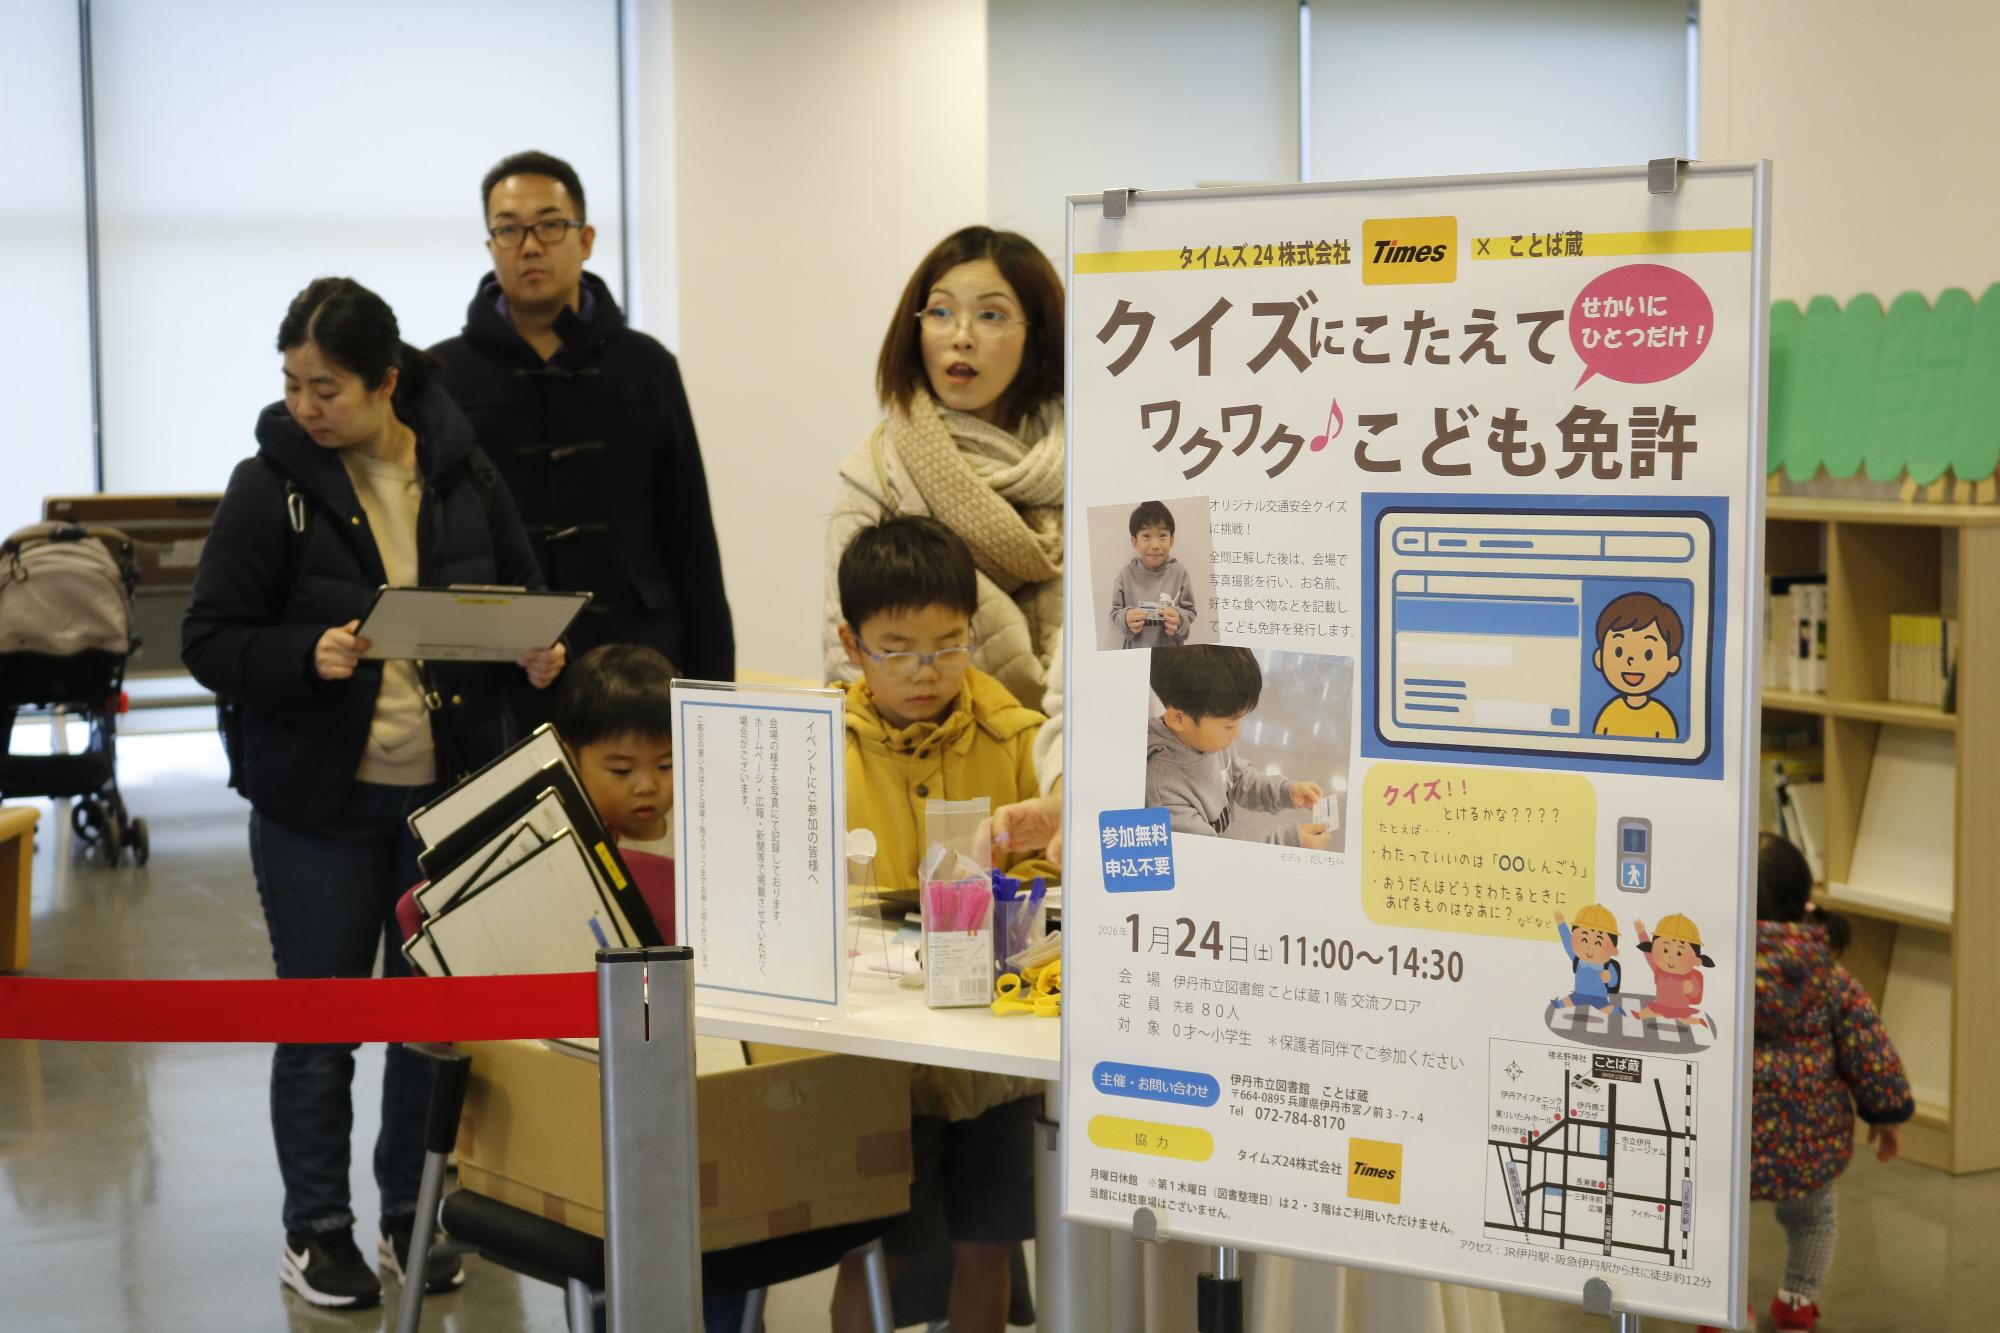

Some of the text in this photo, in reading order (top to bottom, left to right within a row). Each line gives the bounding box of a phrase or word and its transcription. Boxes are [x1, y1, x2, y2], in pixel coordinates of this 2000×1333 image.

[1180, 240, 1351, 270] タイムズ24株式会社
[1373, 238, 1447, 264] Times
[1509, 231, 1584, 258] ことば蔵
[1582, 295, 1668, 319] せかいに
[1097, 289, 1566, 377] クイズにこたえて
[1354, 405, 1698, 481] こども免許
[1209, 499, 1348, 513] オリジナル交通安全クイズ
[1209, 551, 1348, 567] 全問正解した後は、会場で
[1209, 598, 1348, 614] 好きな食べ物などを記載し
[806, 720, 820, 884] イベントにご参加の皆様へ
[1102, 823, 1169, 848] 参加無料
[1105, 856, 1171, 879] 申込不要
[1594, 1056, 1640, 1073] ことば蔵
[1100, 1072, 1209, 1099] 主催・お問い合わせ
[1230, 1073, 1369, 1103] 伊丹市立図書館 ことば蔵
[1230, 1105, 1345, 1131] Tel 072-784-8170
[1090, 1168, 1138, 1186] 月曜日休館
[1237, 1149, 1396, 1180] タイムズ24株式会社 Times
